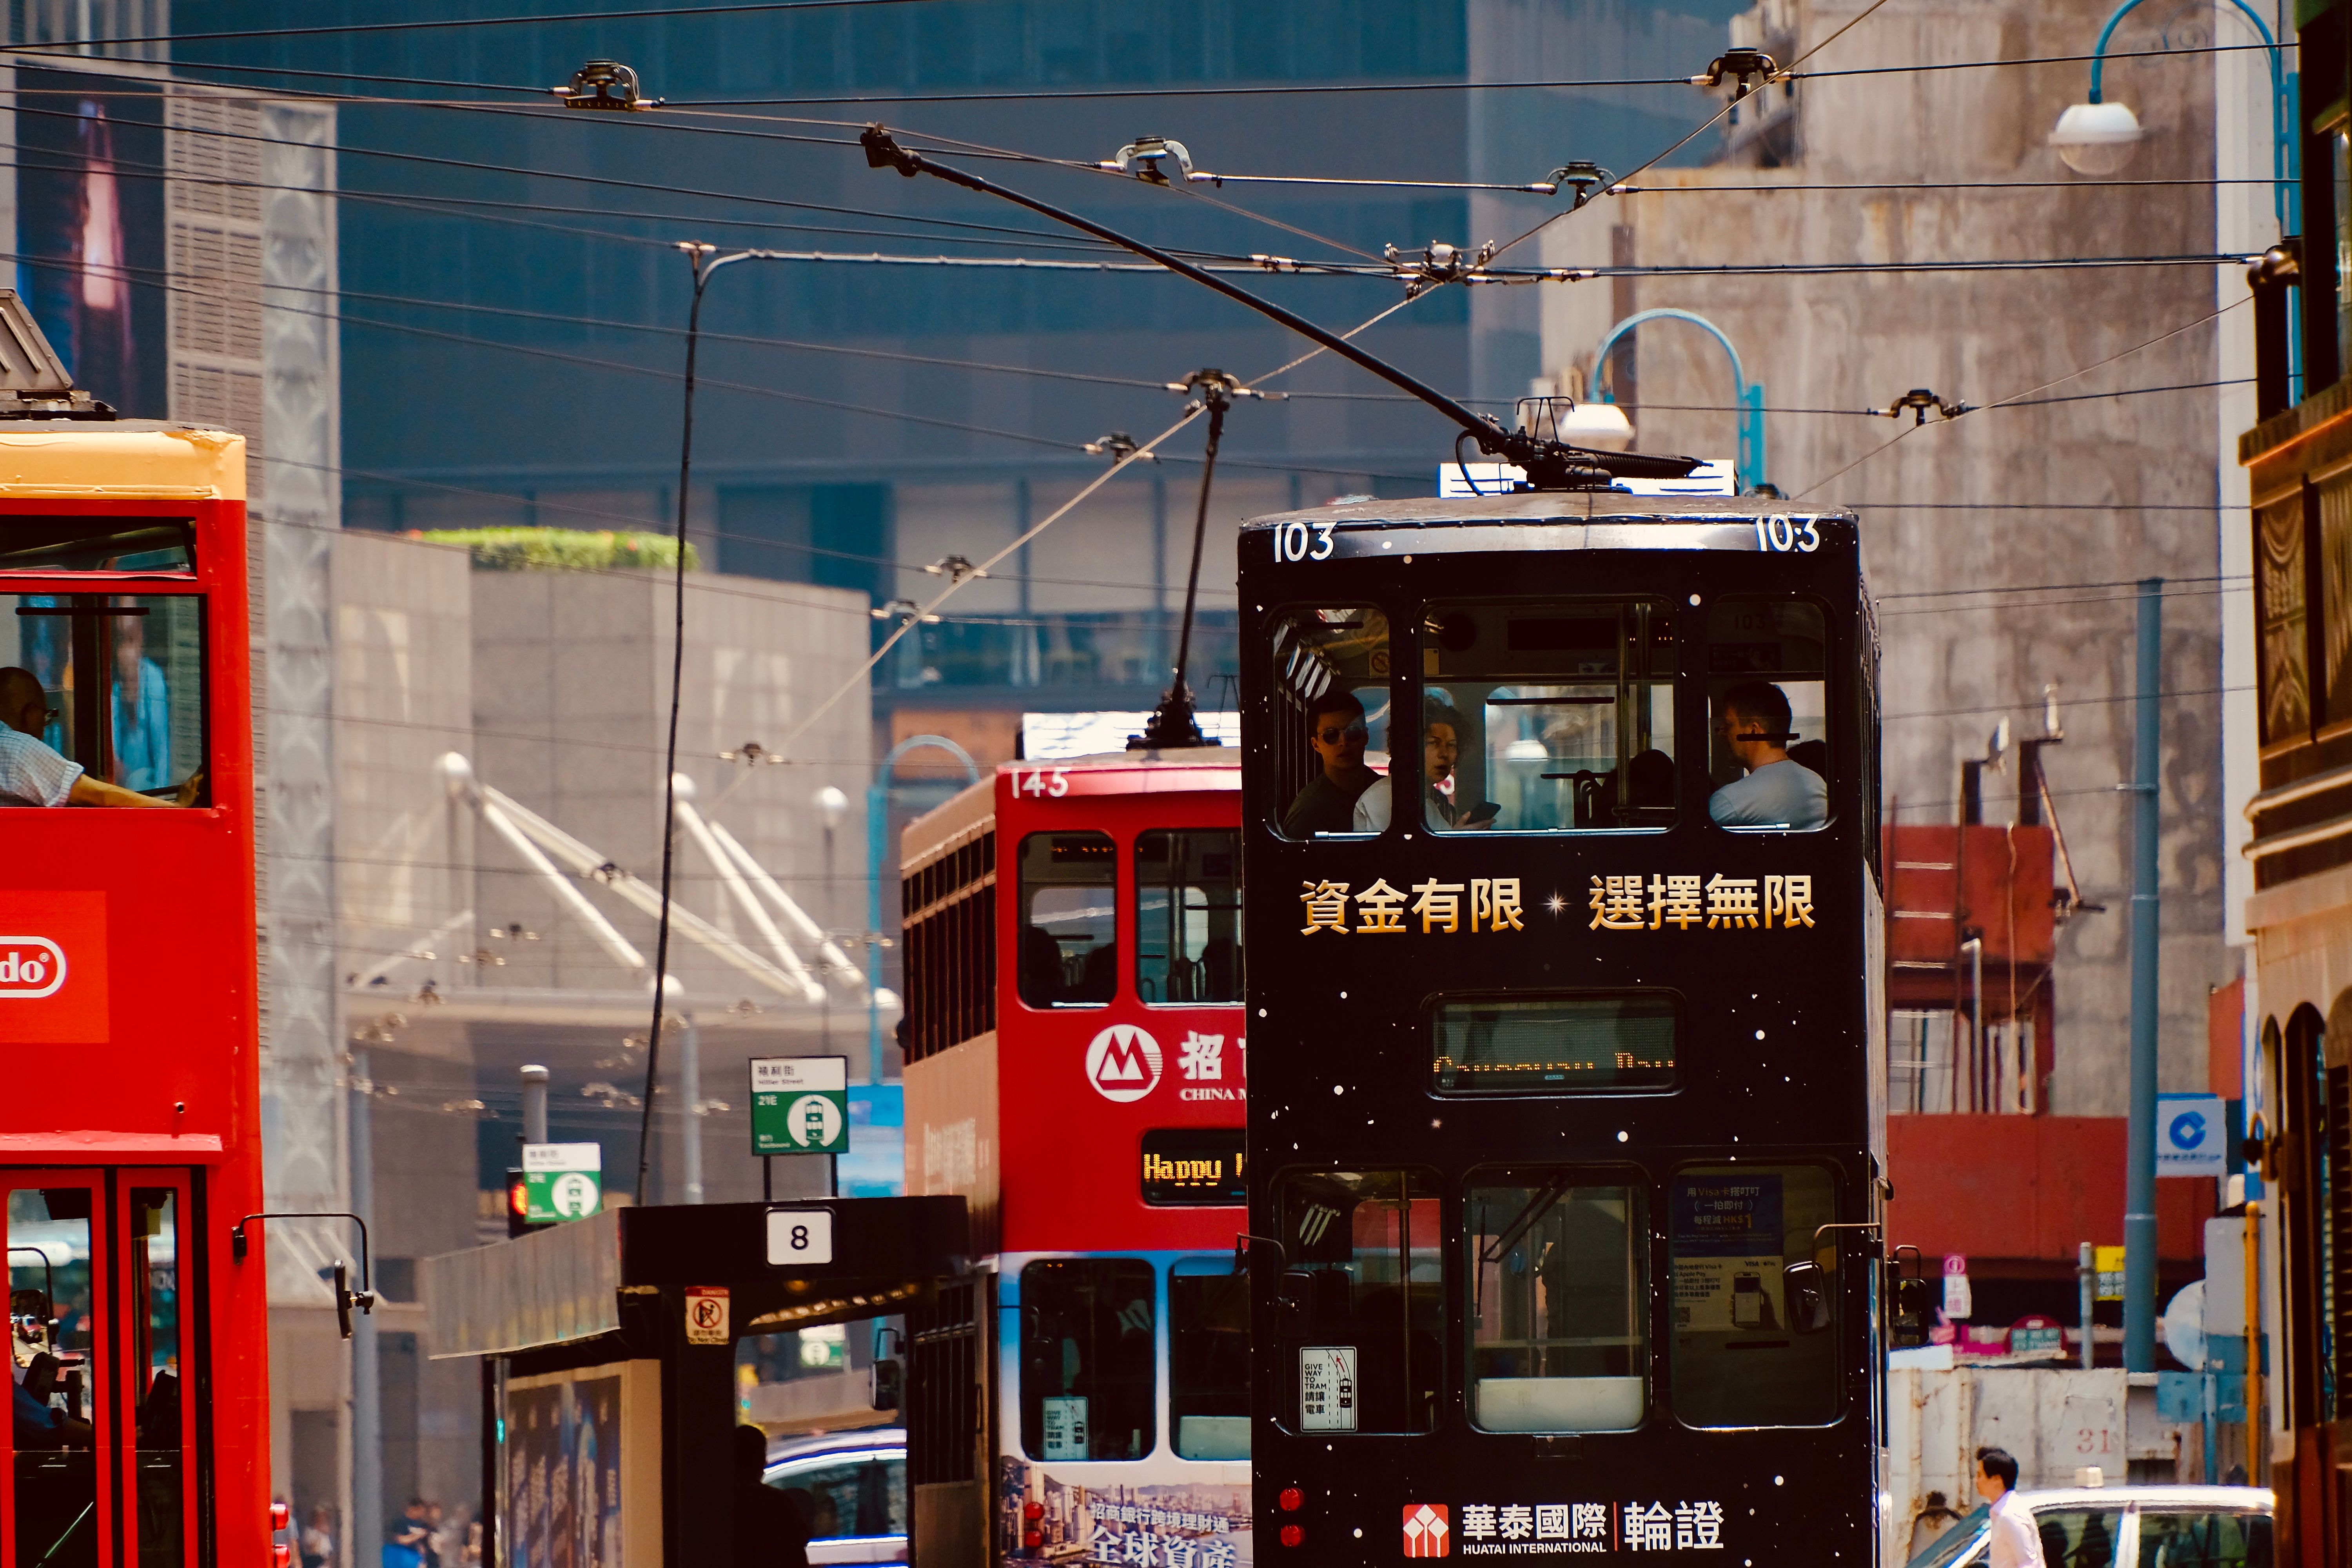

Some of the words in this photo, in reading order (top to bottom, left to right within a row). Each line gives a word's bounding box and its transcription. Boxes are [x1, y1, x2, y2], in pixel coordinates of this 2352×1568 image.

[1275, 522, 1337, 563] 103
[1756, 513, 1820, 552] 103
[1736, 614, 1765, 630] 103
[1011, 767, 1069, 799] 145
[1300, 878, 1524, 936] 資金有限
[1589, 873, 1815, 931] 選擇無限
[1177, 1030, 1246, 1080] 招
[758, 1095, 777, 1105] 21E
[1180, 1088, 1236, 1101] CHINA
[1144, 1154, 1221, 1186] Happy
[1698, 1187, 1720, 1196] Visa
[791, 1225, 808, 1250] 8
[1305, 1392, 1325, 1402] 請讓
[1305, 1404, 1325, 1415] 電車
[2077, 1428, 2111, 1454] 31
[1090, 1502, 1229, 1534] 招商銀行跨境理財通
[1462, 1503, 1607, 1541] 華泰國際
[1624, 1501, 1724, 1551] 輪證
[1463, 1544, 1506, 1555] HUATAI
[1509, 1542, 1607, 1554] INTERNATIONAL
